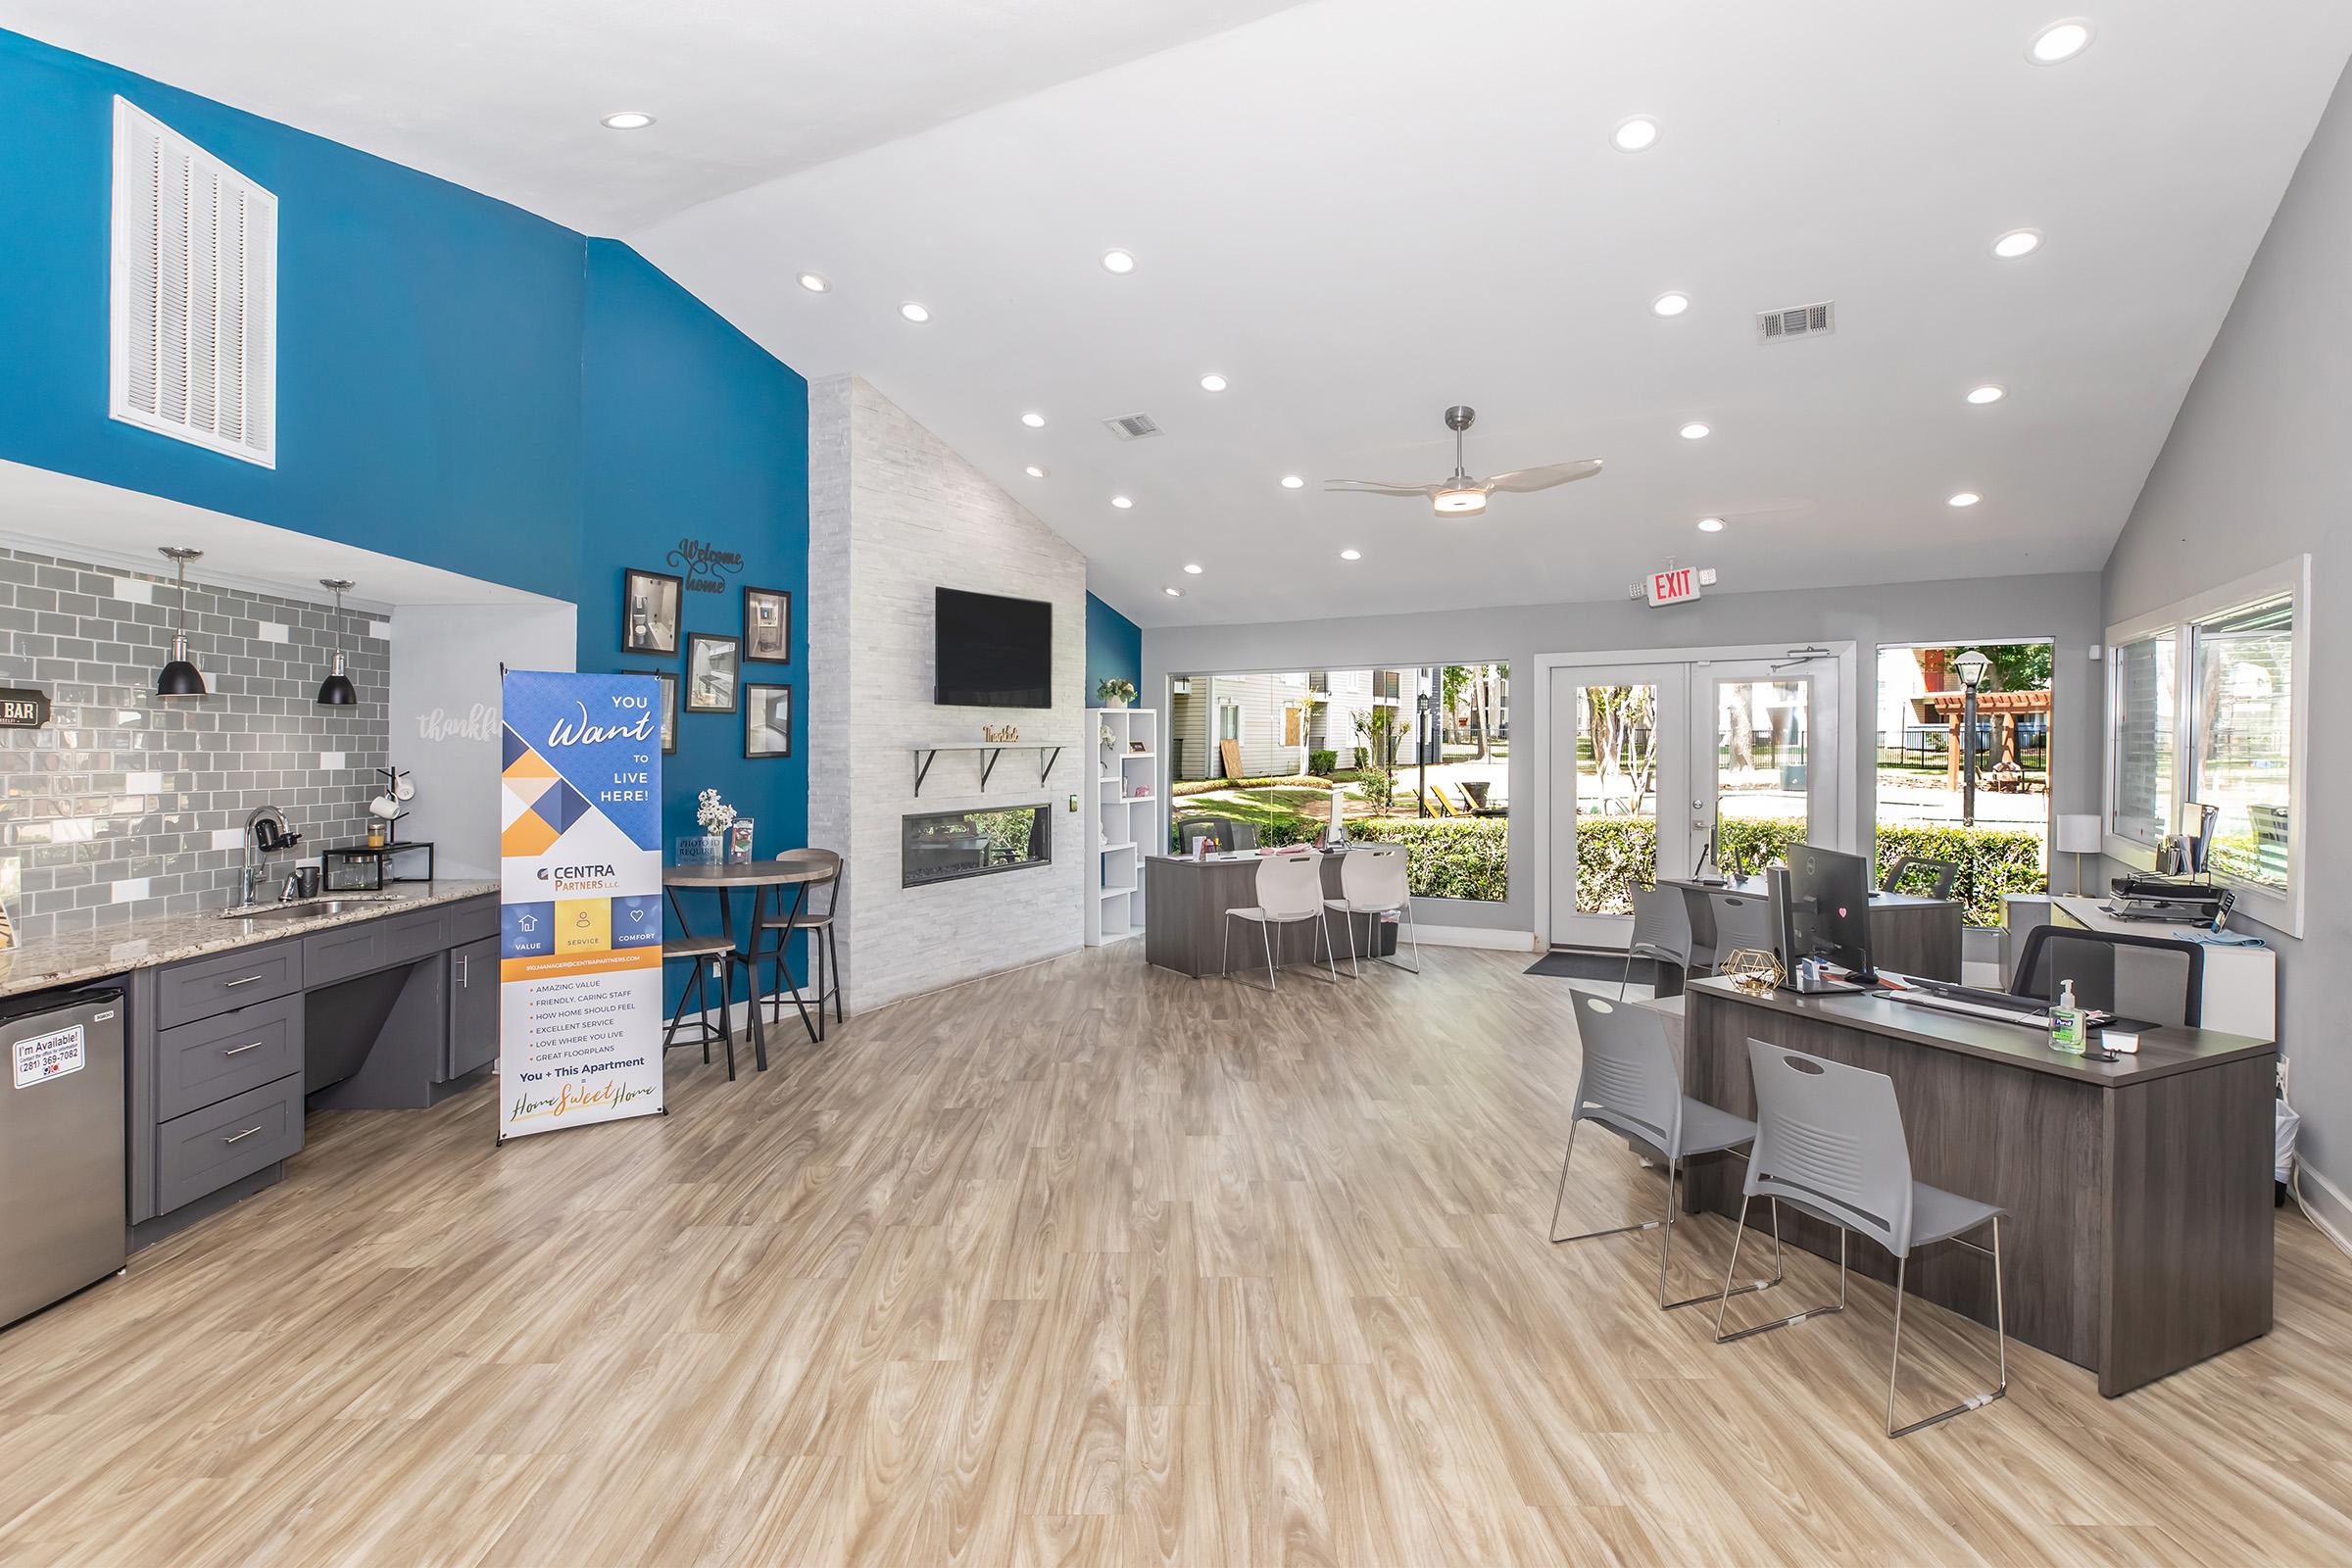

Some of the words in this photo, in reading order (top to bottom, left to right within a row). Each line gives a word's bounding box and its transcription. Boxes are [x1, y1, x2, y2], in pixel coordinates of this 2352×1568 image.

[671, 538, 744, 570] Welcome
[685, 566, 725, 594] home
[4, 702, 34, 719] BAR
[612, 696, 648, 709] YOU
[548, 701, 656, 748] Want
[633, 755, 649, 763] TO
[613, 772, 648, 784] LIVE
[601, 790, 649, 802] HERE!
[554, 863, 615, 880] CENTRA
[515, 942, 542, 951] VALUE
[566, 937, 600, 947] SERVICE
[618, 933, 656, 943] COMFORT
[536, 982, 574, 994] AMAZING
[575, 980, 601, 990] VALUE
[577, 992, 608, 1003] CARING
[609, 990, 632, 1000] STAFF
[536, 1011, 557, 1020] HOW
[558, 1008, 582, 1018] HOME
[584, 1004, 616, 1015] SHOULD
[617, 1003, 636, 1011] FEEL
[536, 1022, 580, 1035] EXCELLENT
[581, 1018, 614, 1029] SERVICE
[20, 1046, 33, 1057] I'm
[35, 1031, 78, 1053] Available!
[536, 1039, 557, 1049] LOVE
[559, 1035, 588, 1045] WHERE
[608, 1030, 624, 1039] LIVE
[20, 1059, 40, 1073] (281)
[42, 1049, 78, 1066] 369-7082
[536, 1052, 563, 1062] GREAT
[564, 1045, 615, 1059] FLOORPLANS
[519, 1072, 543, 1083] You
[555, 1065, 579, 1078] This
[581, 1056, 646, 1075] Apartment
[510, 1093, 560, 1122] Home
[554, 1080, 615, 1117] Sweet
[611, 1082, 658, 1110] Home
